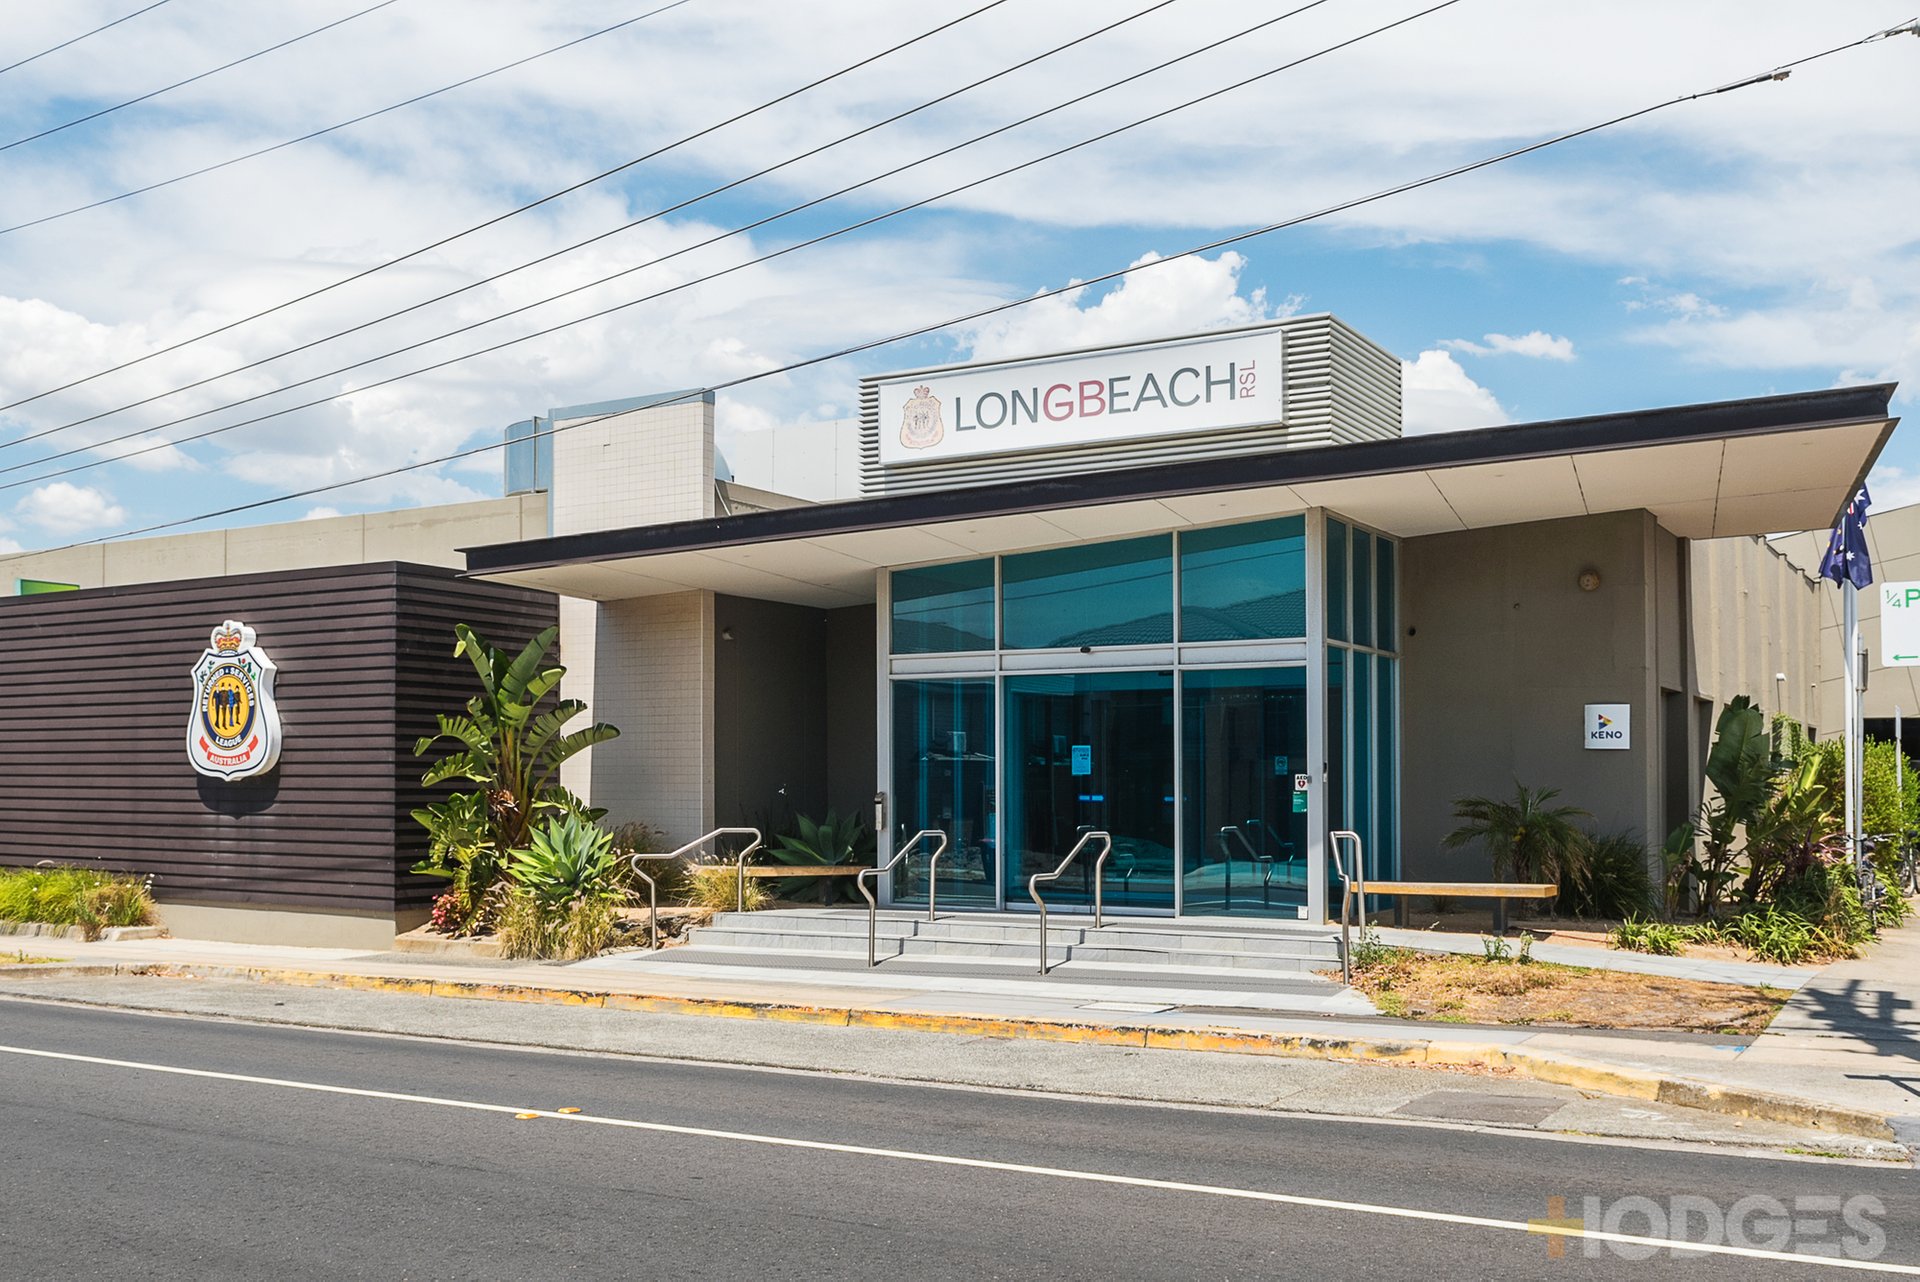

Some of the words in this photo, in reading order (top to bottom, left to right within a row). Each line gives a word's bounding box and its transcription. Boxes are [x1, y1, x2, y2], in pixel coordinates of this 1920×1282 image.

[1239, 359, 1256, 399] RSL
[955, 362, 1235, 432] LONGBEACH
[202, 668, 225, 712] RETURNED
[230, 667, 255, 707] SERVICES
[216, 736, 242, 747] LEAGUE
[1590, 730, 1623, 740] KENO
[210, 755, 247, 765] AUSTRALIA
